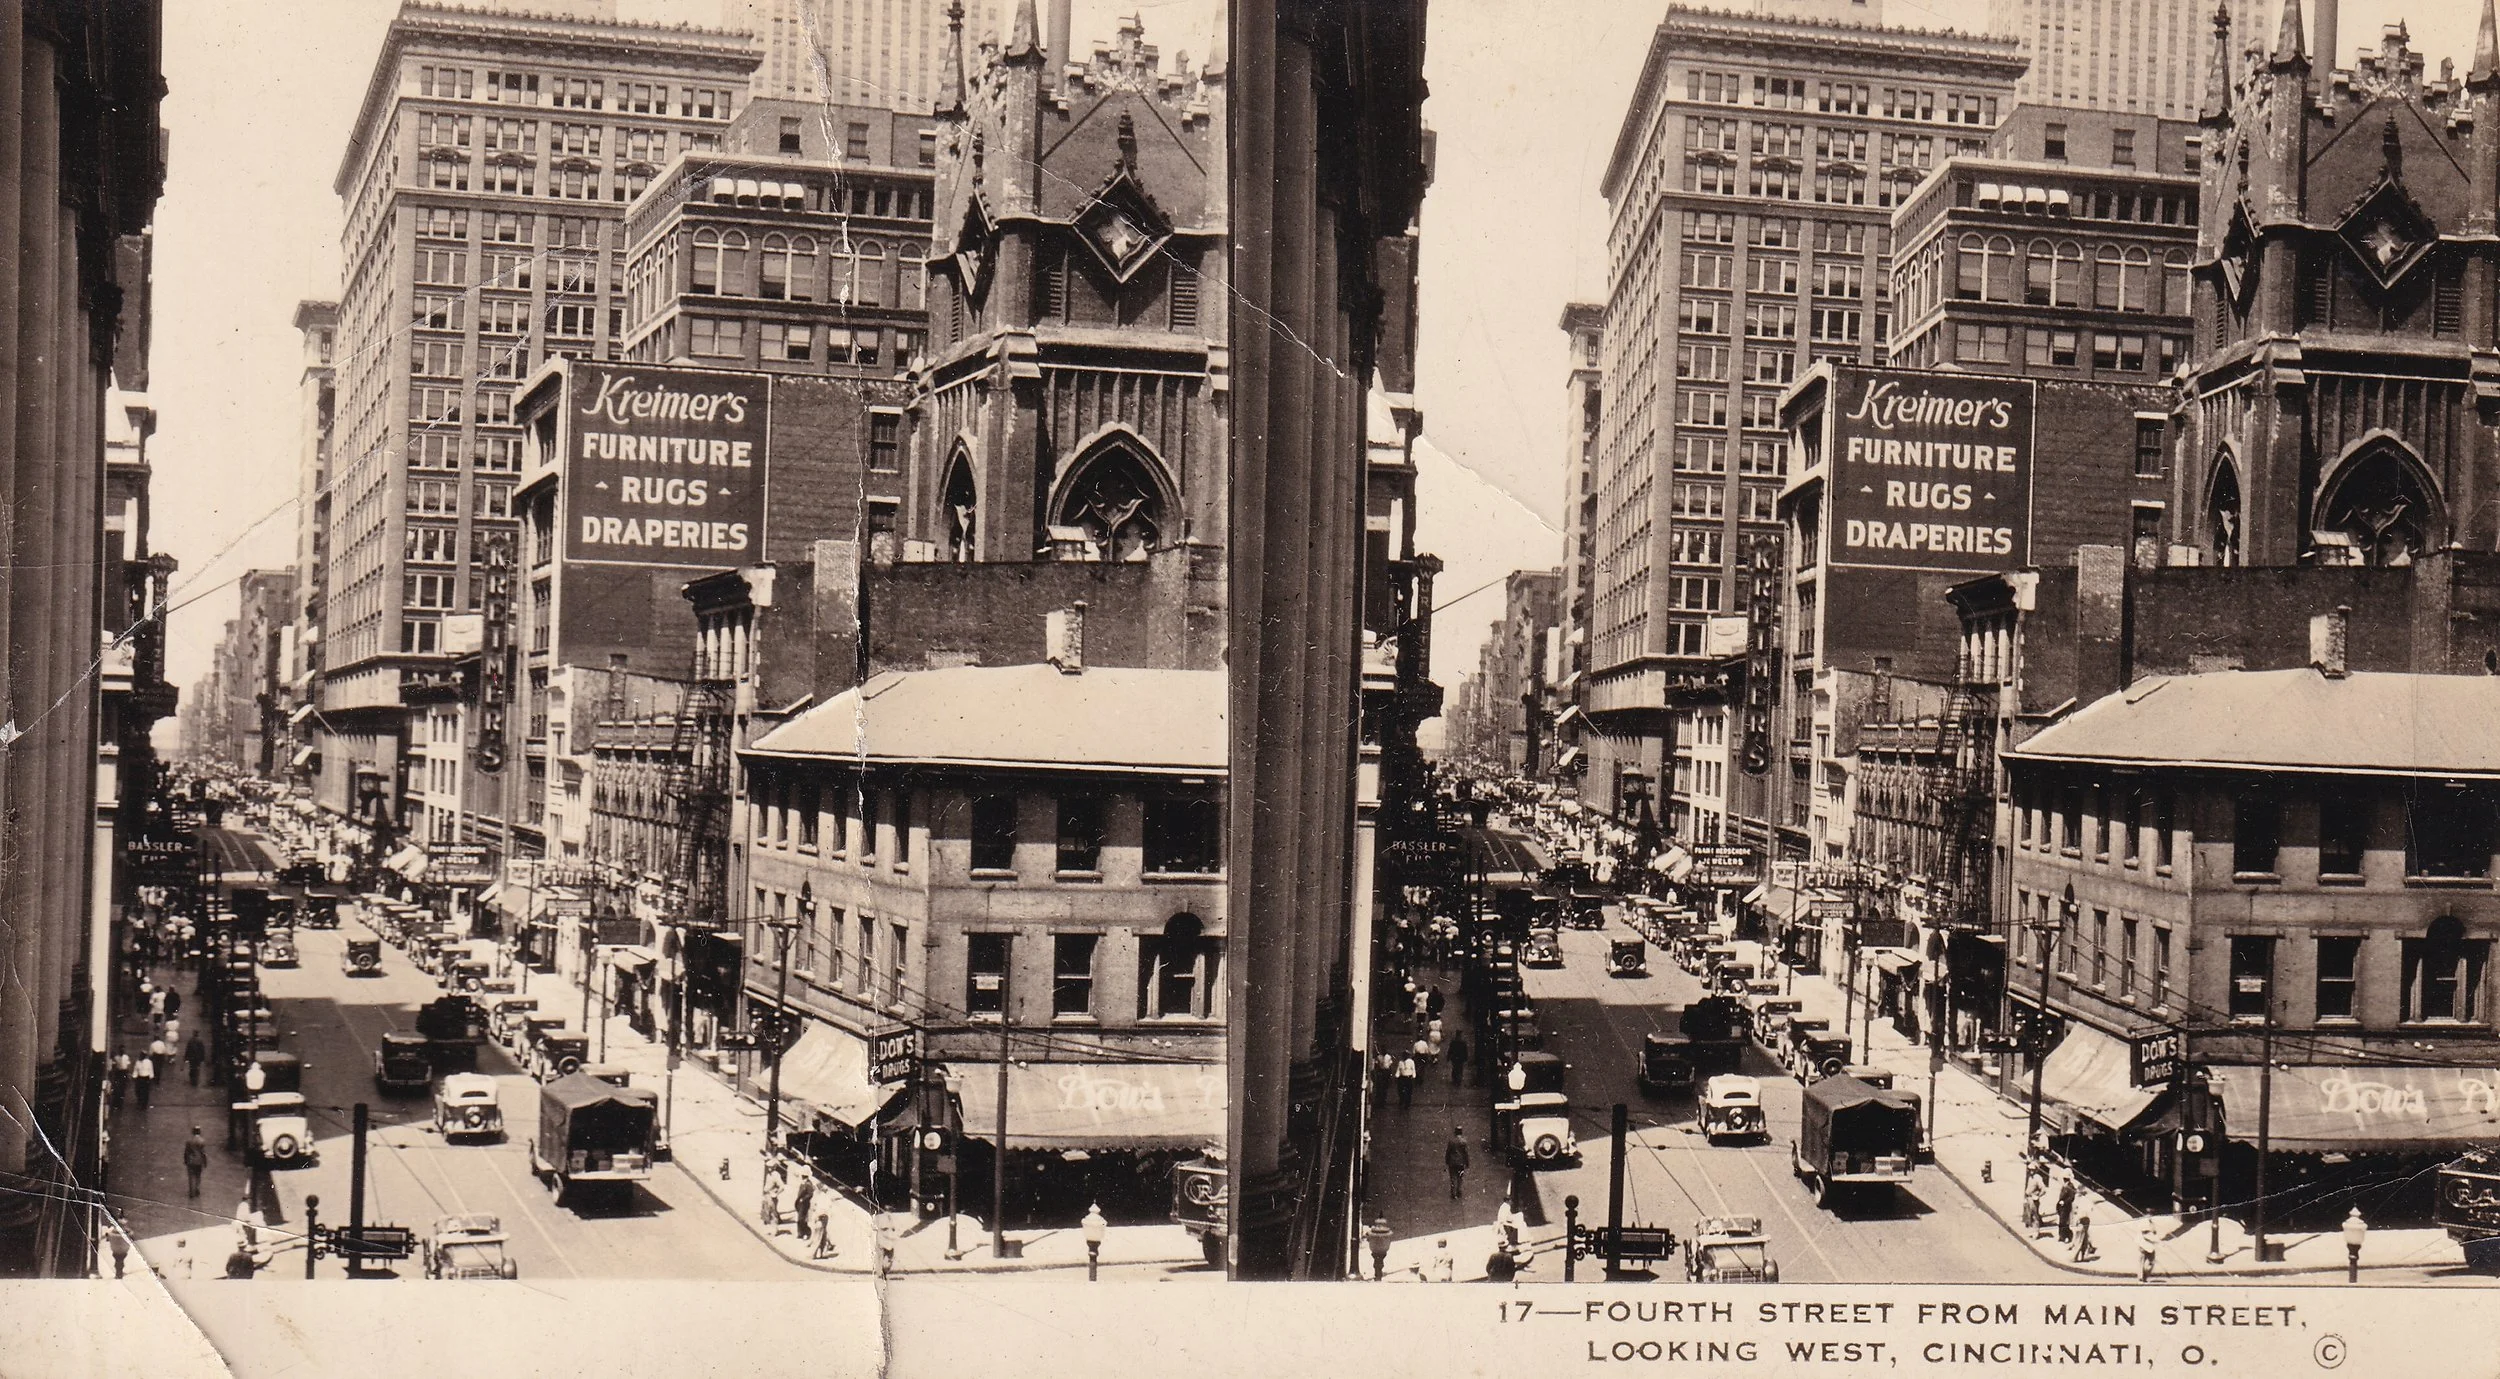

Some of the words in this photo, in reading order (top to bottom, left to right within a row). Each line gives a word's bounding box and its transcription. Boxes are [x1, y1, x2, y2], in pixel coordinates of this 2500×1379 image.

[581, 374, 748, 424] Kreimer's
[1846, 379, 2012, 430] Kreimer's
[582, 432, 752, 467] FURNITURE
[1847, 437, 2017, 472] FURNITURE
[621, 476, 708, 506] RUGS
[1886, 480, 1973, 510] RUGS
[581, 516, 748, 550] DRAPERIES
[1846, 519, 2013, 555] DRAPERIES
[878, 1033, 915, 1061] DOW'S
[2140, 1035, 2178, 1063] DOW'S
[881, 1058, 911, 1079] DRUGS
[2143, 1061, 2174, 1081] DRUGS
[1058, 1074, 1166, 1127] Dow's
[2320, 1078, 2429, 1131] Dow's
